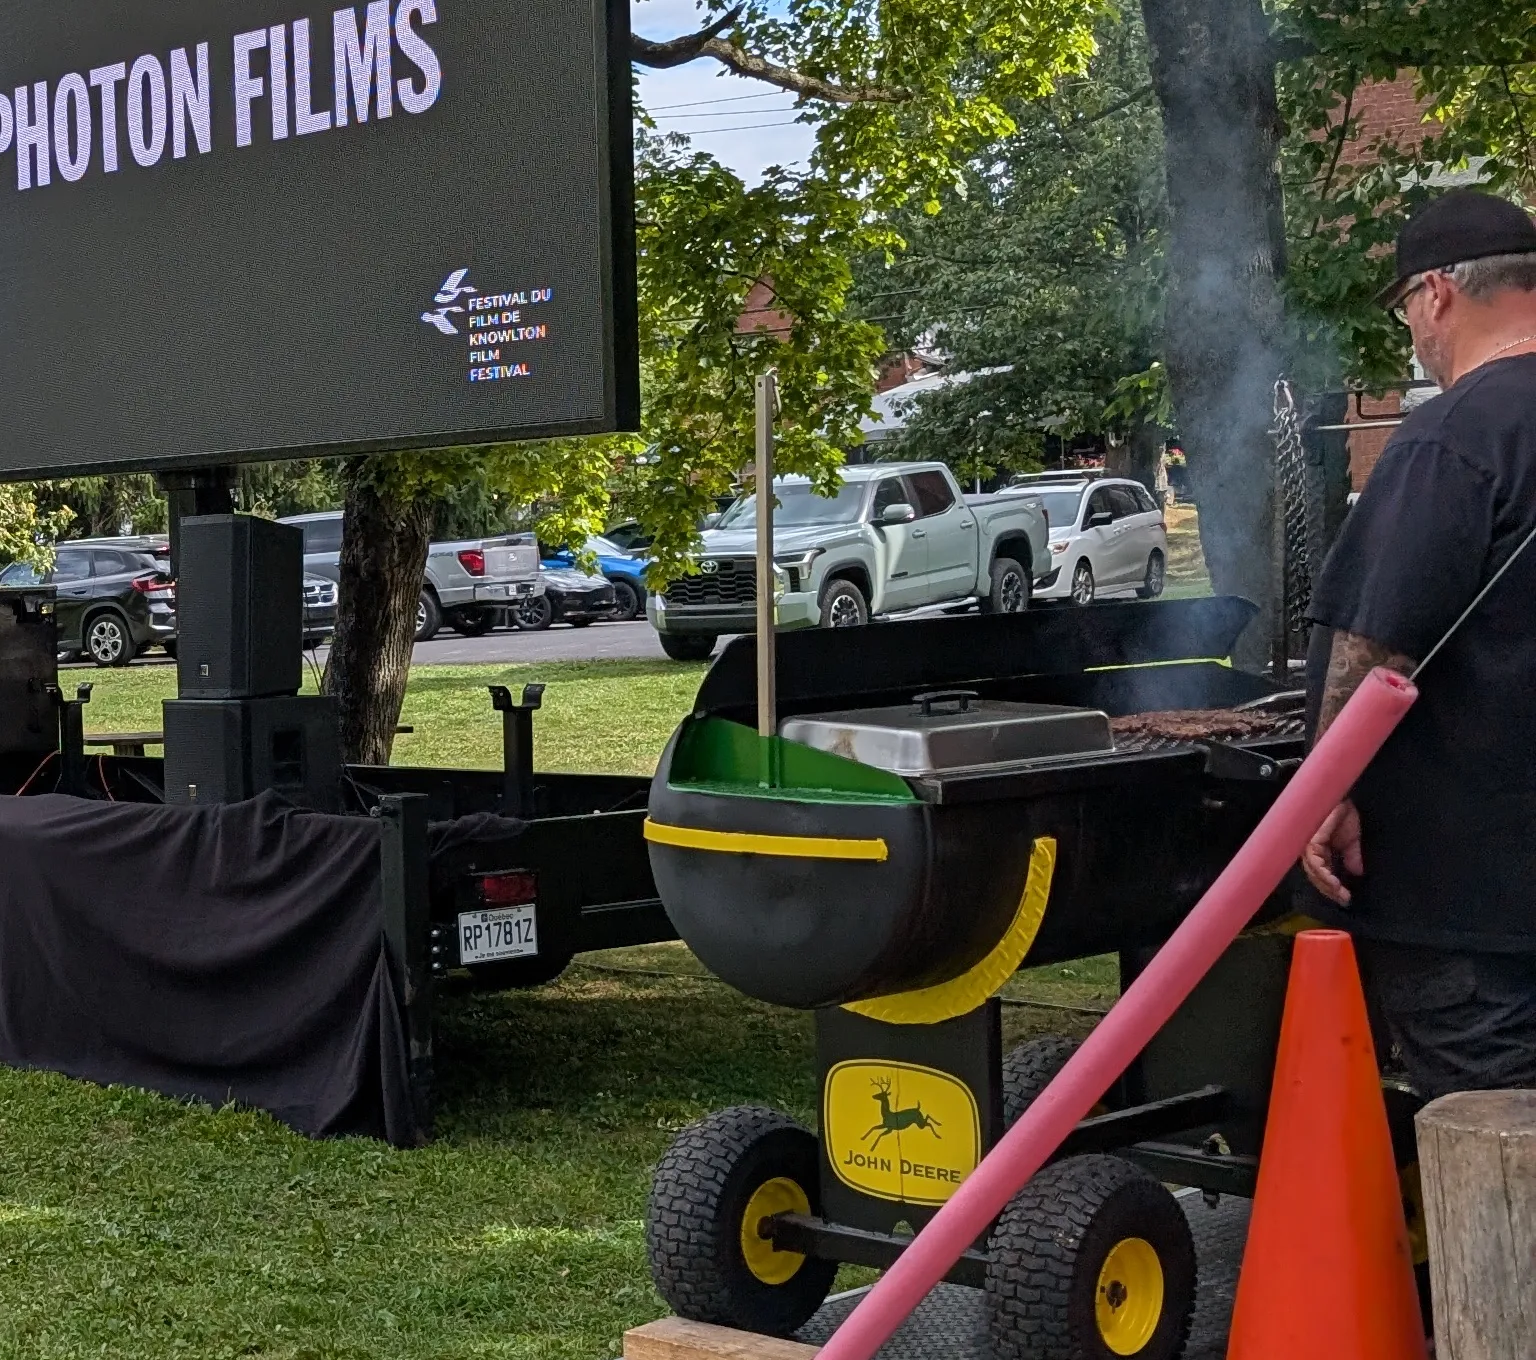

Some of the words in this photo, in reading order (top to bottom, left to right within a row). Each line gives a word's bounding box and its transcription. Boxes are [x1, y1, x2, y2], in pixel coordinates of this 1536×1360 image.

[468, 292, 528, 311] FESTIVAL
[530, 288, 552, 303] DU
[469, 313, 499, 328] FILM
[502, 310, 521, 324] DE
[469, 324, 547, 346] KNOWLTON
[469, 349, 500, 363] FILM
[470, 363, 531, 382] FESTIVAL
[463, 918, 534, 951] RP1781Z
[843, 1150, 892, 1172] JOHN
[900, 1159, 961, 1184] DEERE
